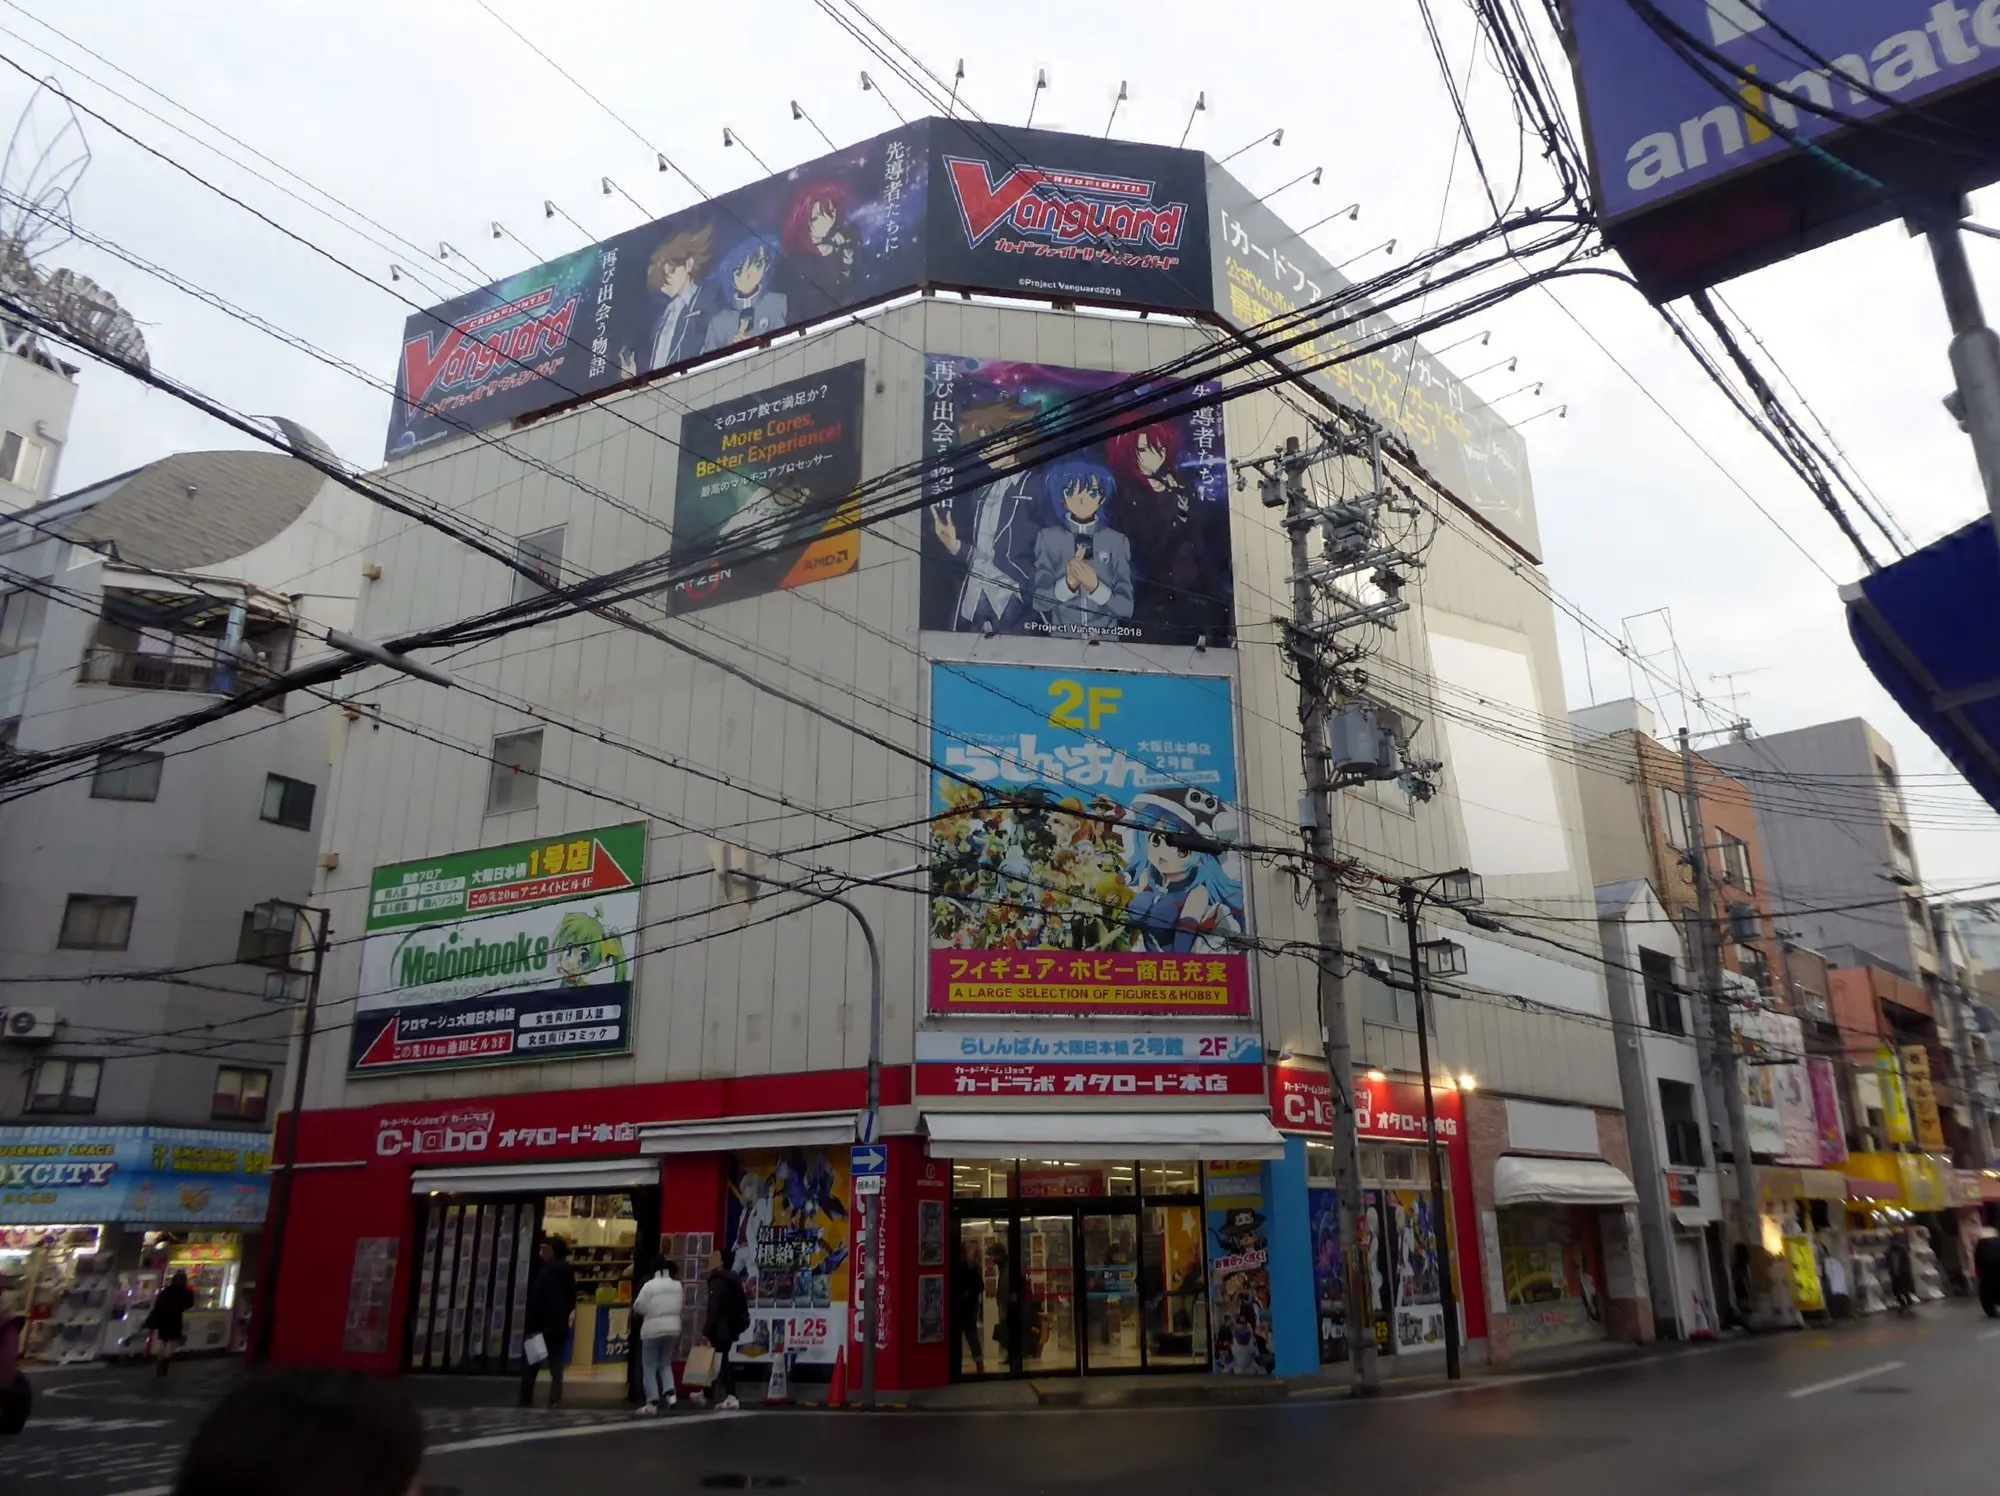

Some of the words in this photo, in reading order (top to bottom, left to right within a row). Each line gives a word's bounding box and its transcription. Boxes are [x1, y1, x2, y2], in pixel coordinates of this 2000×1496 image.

[884, 141, 905, 253] 先導者たちに
[945, 159, 1183, 249] Vanguard
[589, 247, 618, 377] 再び出会う物語
[404, 298, 578, 417] Vanguard
[695, 452, 745, 478] Better
[747, 421, 843, 464] Experience!
[721, 427, 763, 451] More
[766, 411, 816, 437] Cores,
[803, 553, 837, 572] AMD
[1047, 679, 1123, 731] 2F
[945, 734, 1147, 788] らしんばん
[529, 840, 592, 878] 1号店
[399, 930, 550, 987] Melonbooks
[949, 957, 1228, 983] フィギュア・ホビー商品充実
[954, 988, 963, 999] A
[968, 988, 1012, 1000] LARGE
[1018, 988, 1089, 1000] SELECTION
[1093, 988, 1110, 1000] OF
[1199, 1037, 1228, 1057] 2F
[954, 1075, 1056, 1093] カードラボ
[1064, 1074, 1229, 1093] オタロード本店
[1284, 1094, 1371, 1128] C-lao
[497, 1122, 635, 1147] オタロード本店
[787, 1318, 828, 1338] 1.25
